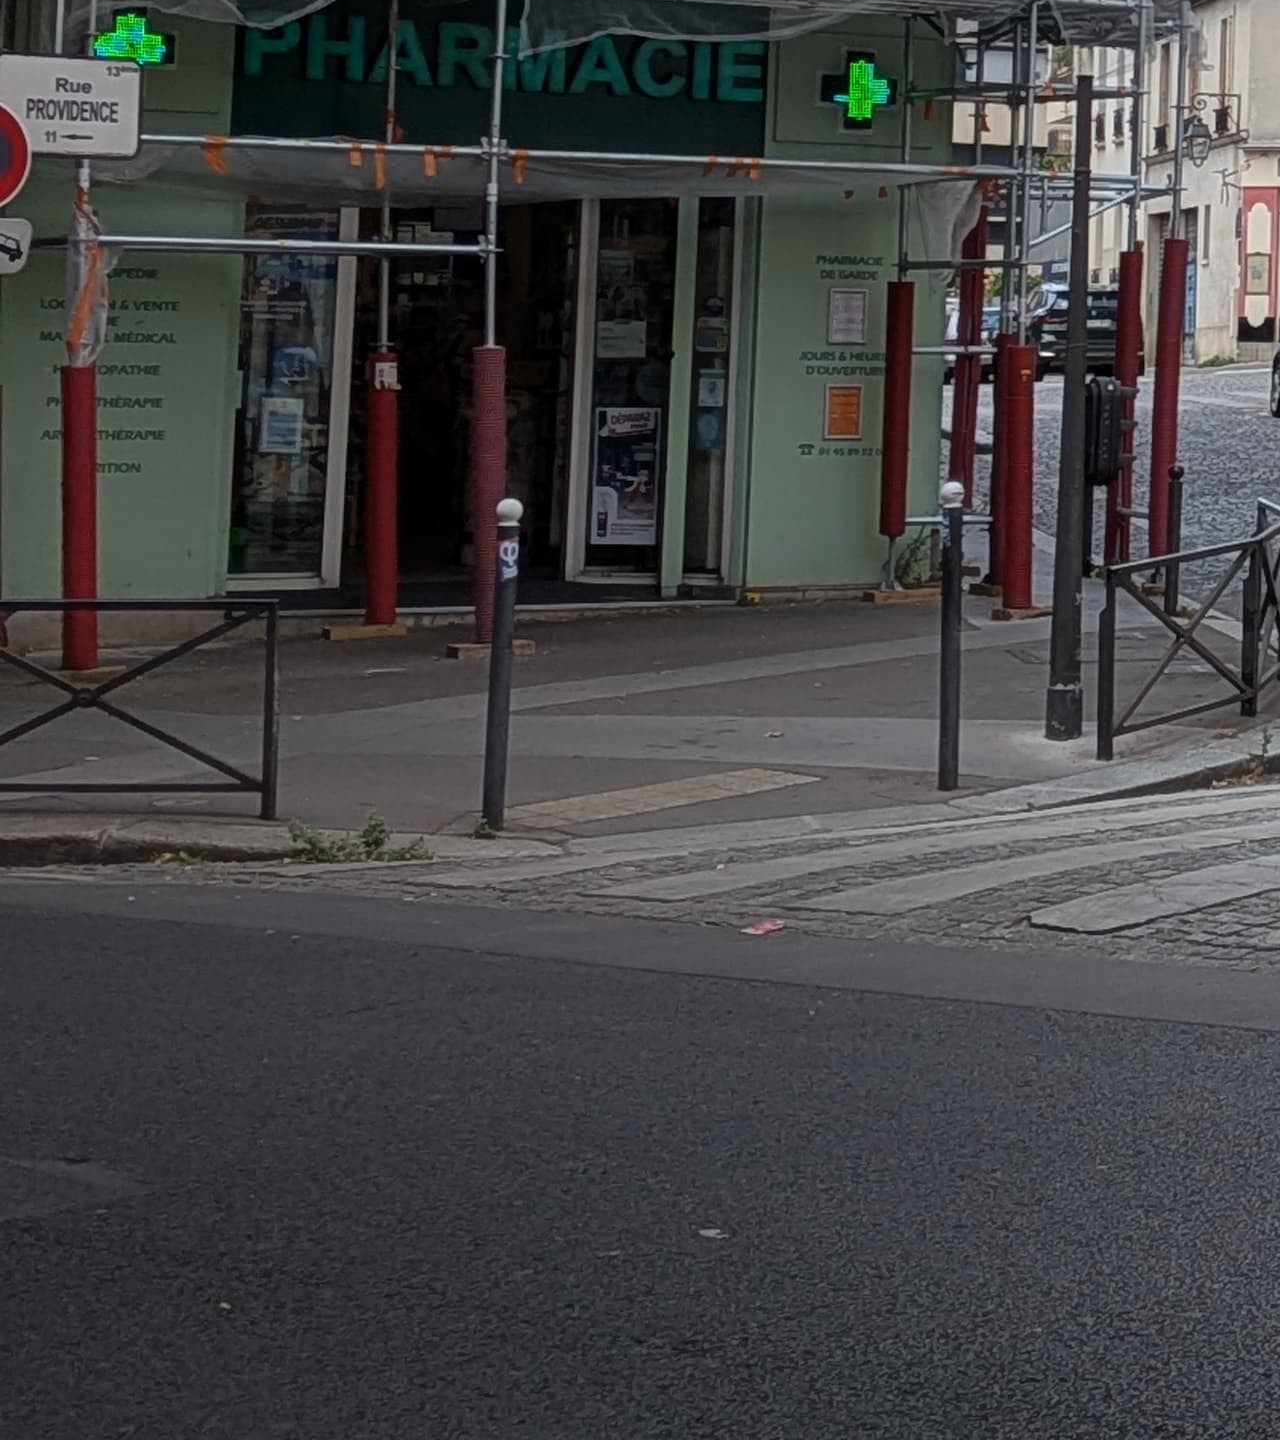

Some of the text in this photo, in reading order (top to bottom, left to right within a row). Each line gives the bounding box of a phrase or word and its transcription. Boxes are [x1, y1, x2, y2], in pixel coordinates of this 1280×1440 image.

[244, 12, 764, 101] PHARMACIE
[55, 77, 93, 94] Rue
[26, 98, 119, 123] PROVIDENCE
[44, 131, 57, 143] 11
[134, 301, 180, 311] VENTE
